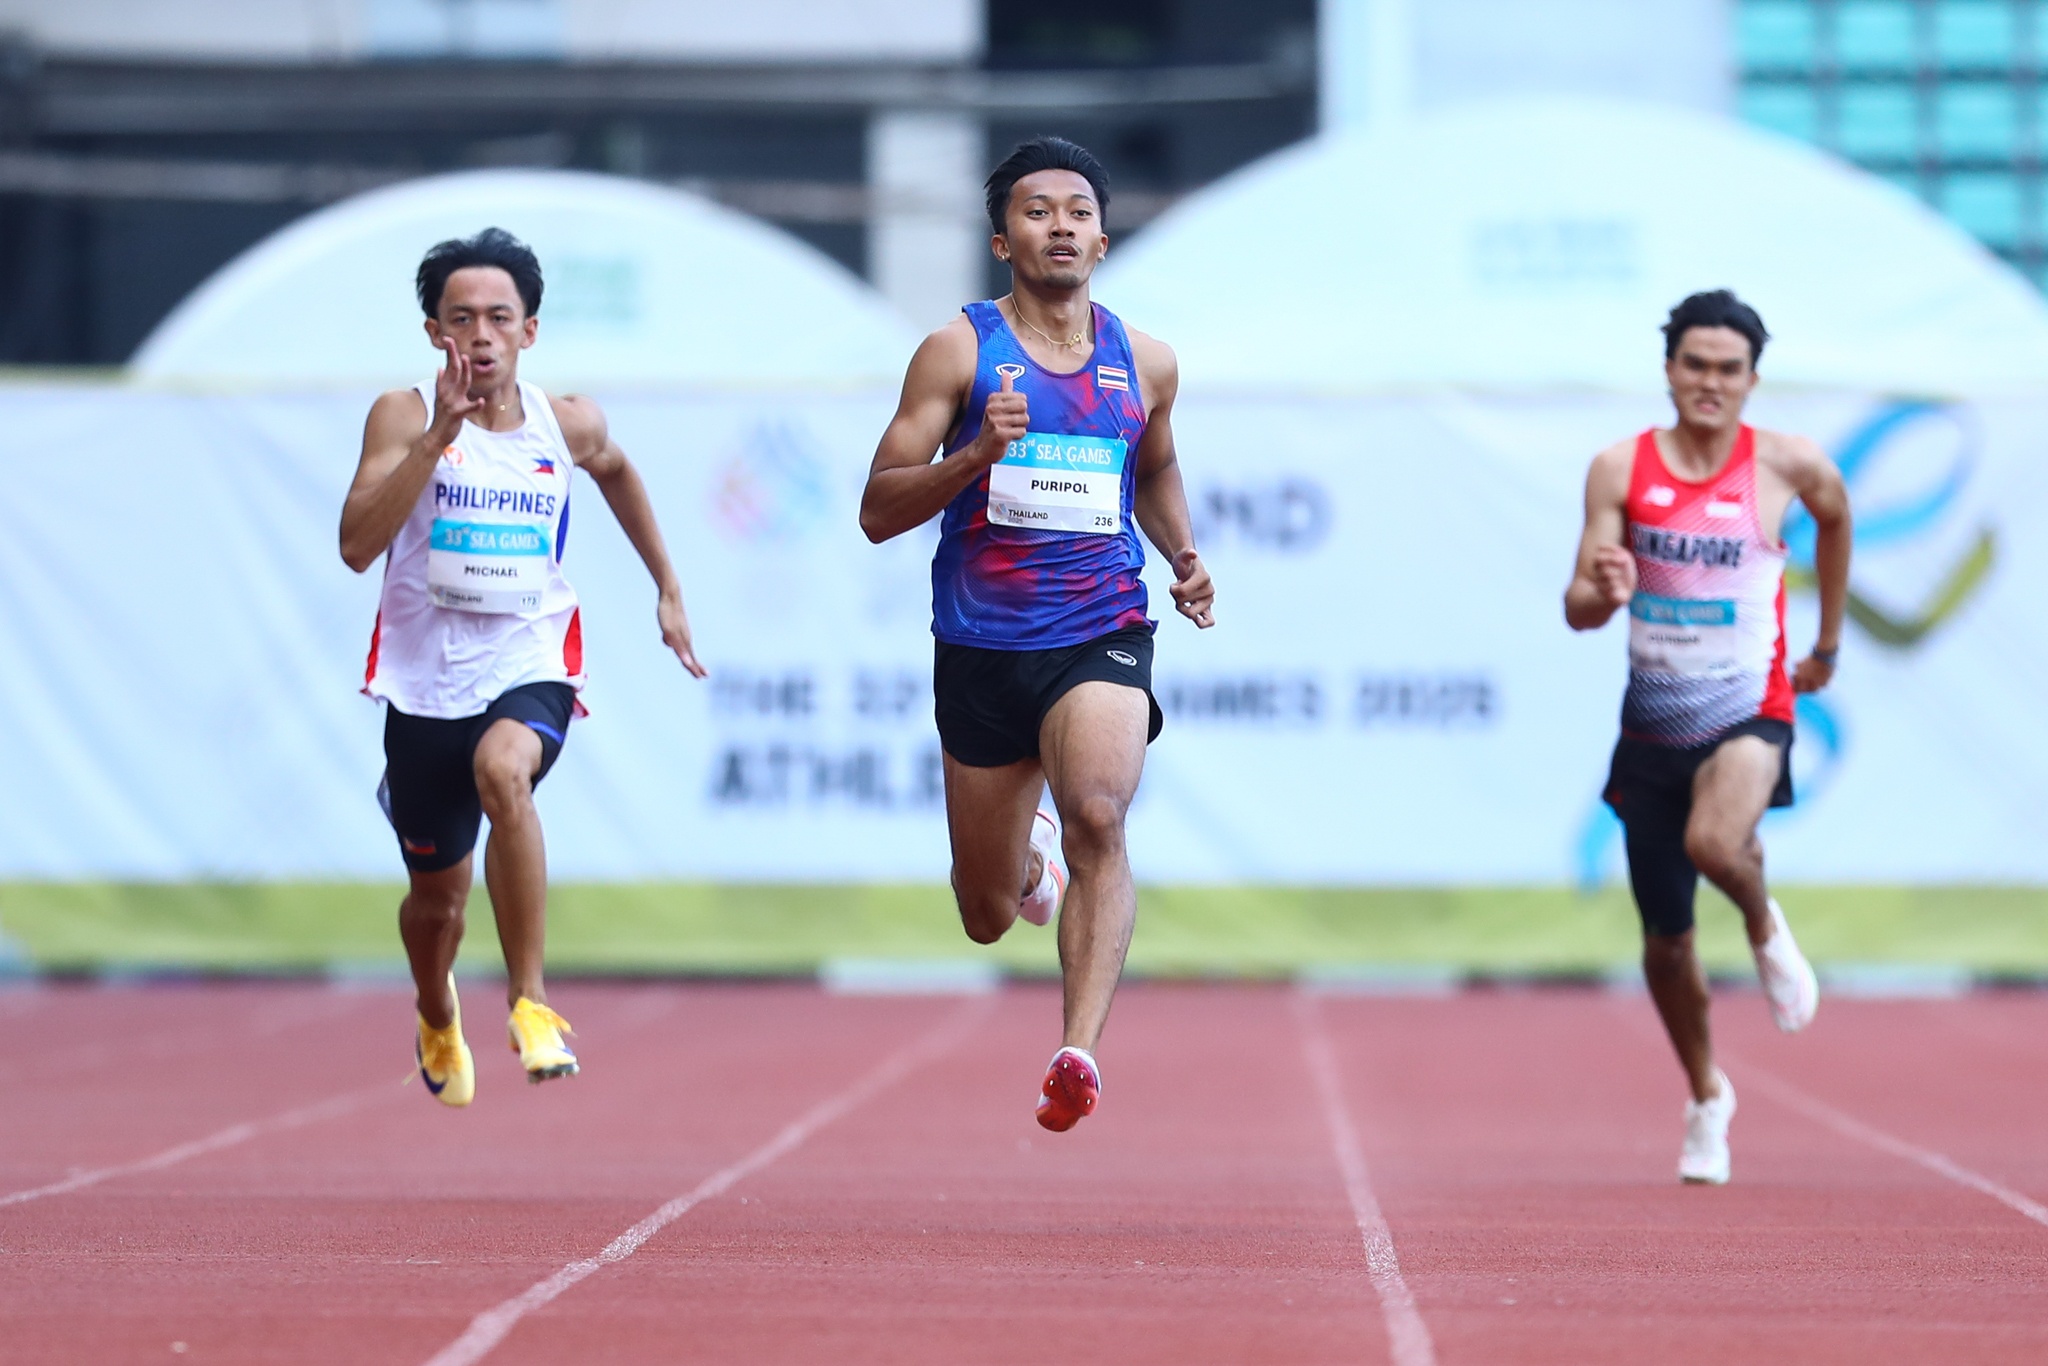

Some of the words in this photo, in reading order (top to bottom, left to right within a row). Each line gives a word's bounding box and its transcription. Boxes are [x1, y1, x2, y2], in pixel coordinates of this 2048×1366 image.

[1008, 439, 1035, 458] 33rd
[1036, 444, 1062, 461] SEA
[1066, 446, 1112, 465] GAMES
[1030, 479, 1090, 494] PURIPOL
[435, 483, 556, 516] PHILIPPINES
[1008, 509, 1049, 520] THAILAND
[1094, 516, 1113, 527] 236
[470, 531, 497, 549] SEA
[500, 532, 541, 550] GAMES
[1630, 523, 1745, 568] SINGAPORE
[464, 564, 519, 578] MICHAEL
